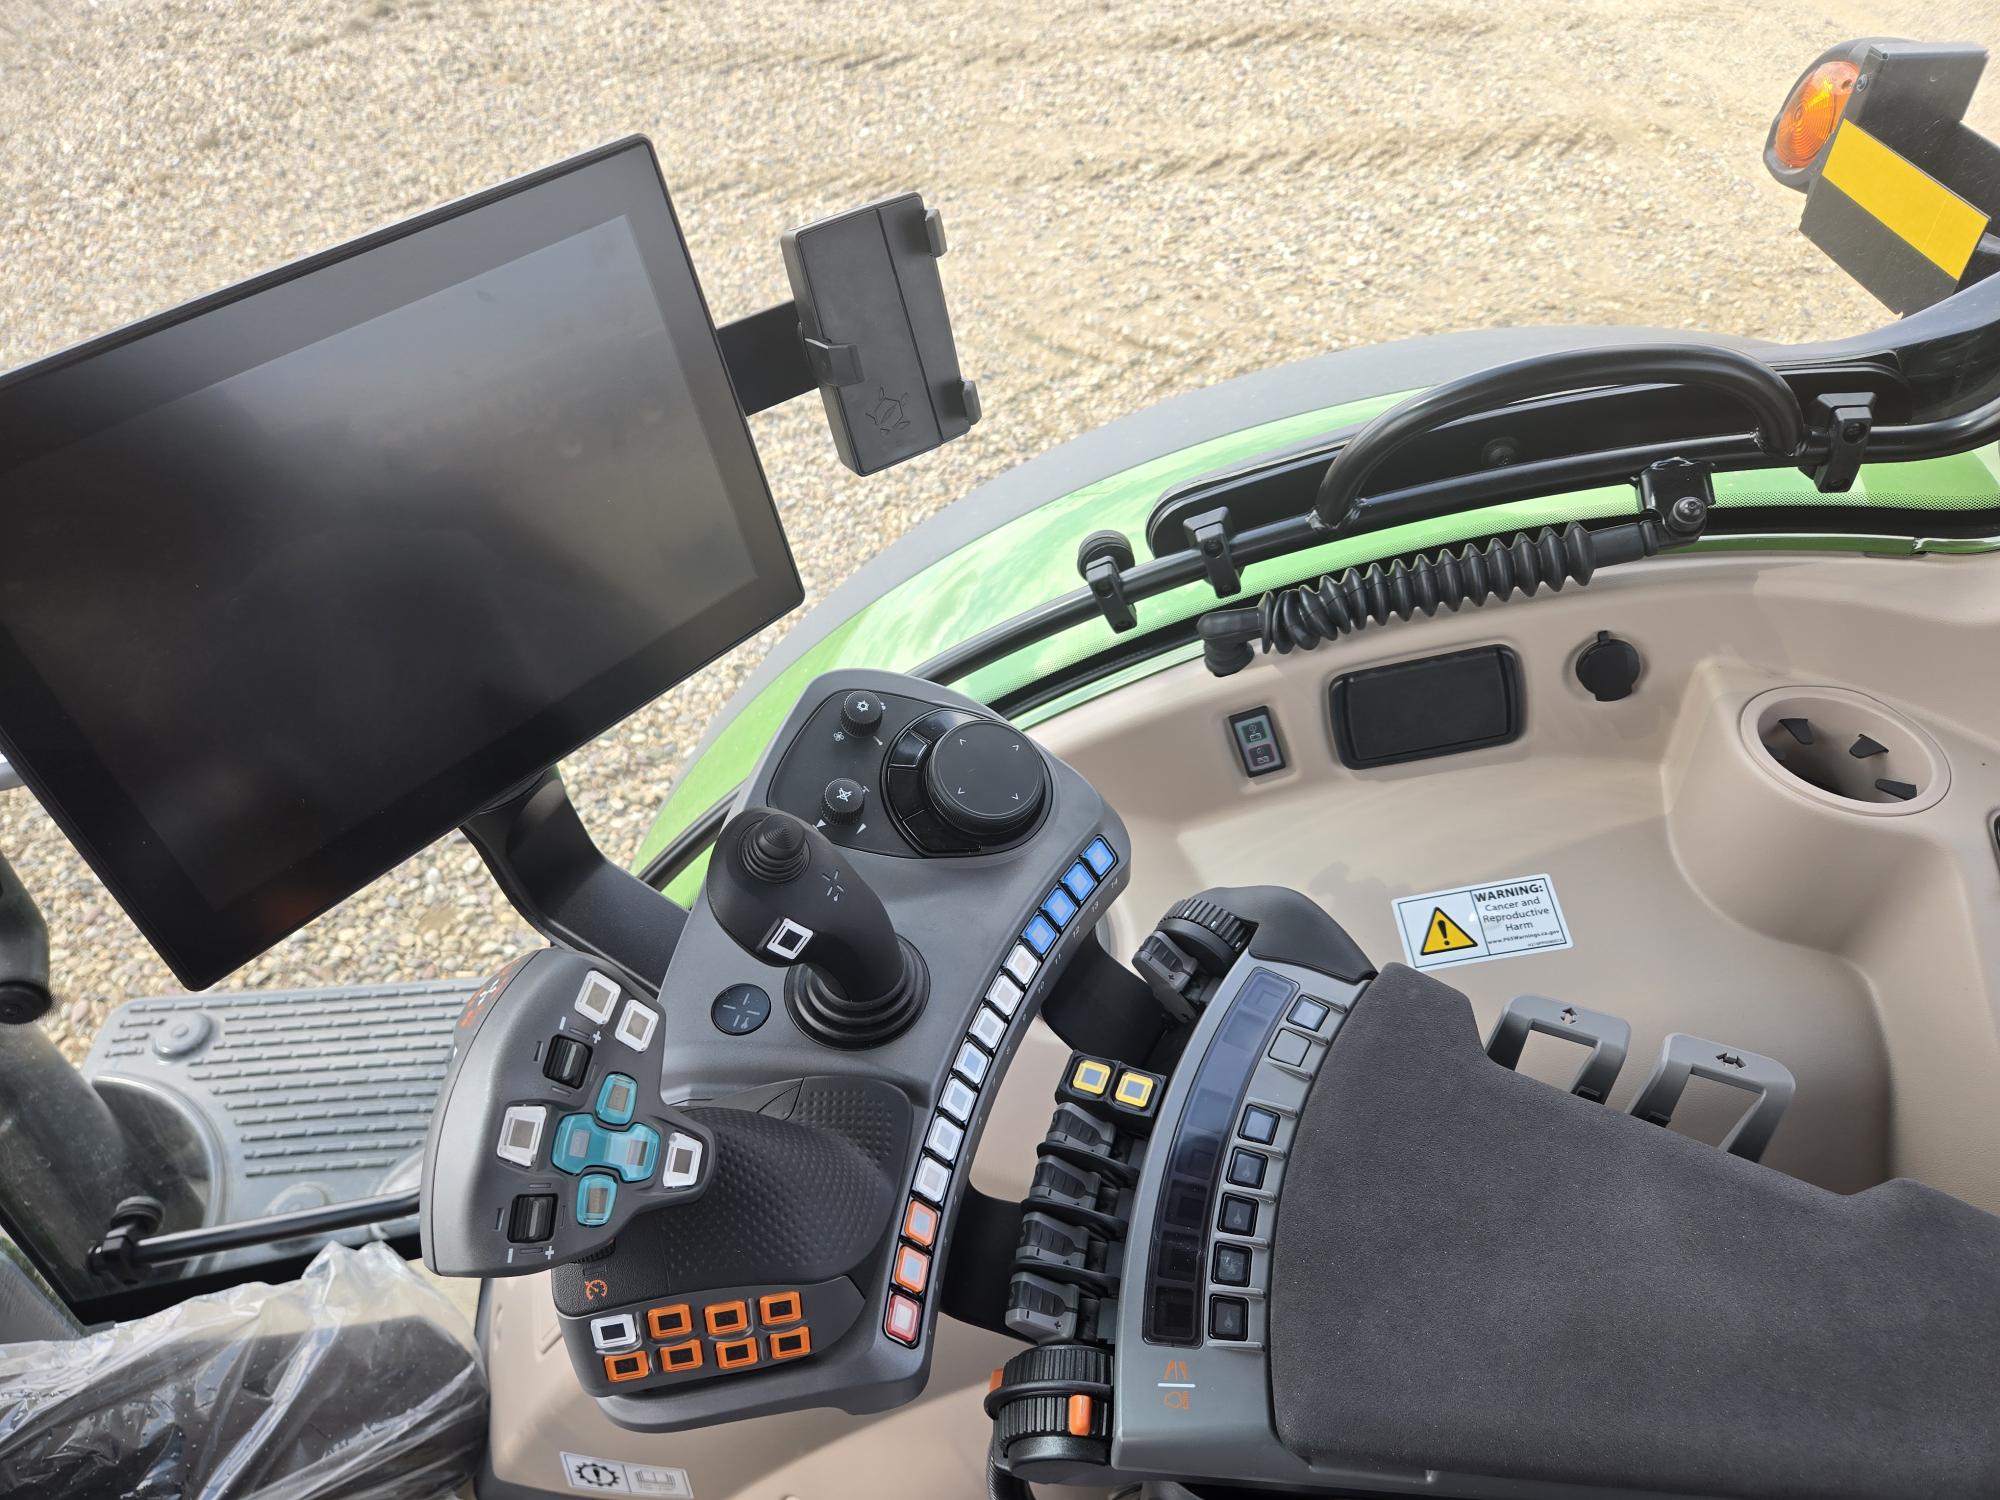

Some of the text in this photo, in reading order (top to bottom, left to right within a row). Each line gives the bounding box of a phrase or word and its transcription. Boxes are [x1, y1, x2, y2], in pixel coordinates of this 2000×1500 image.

[1474, 884, 1544, 902] WARNING:
[1485, 896, 1541, 911] Cancer and
[1482, 908, 1550, 923] Reproductive
[1505, 921, 1534, 932] Harm
